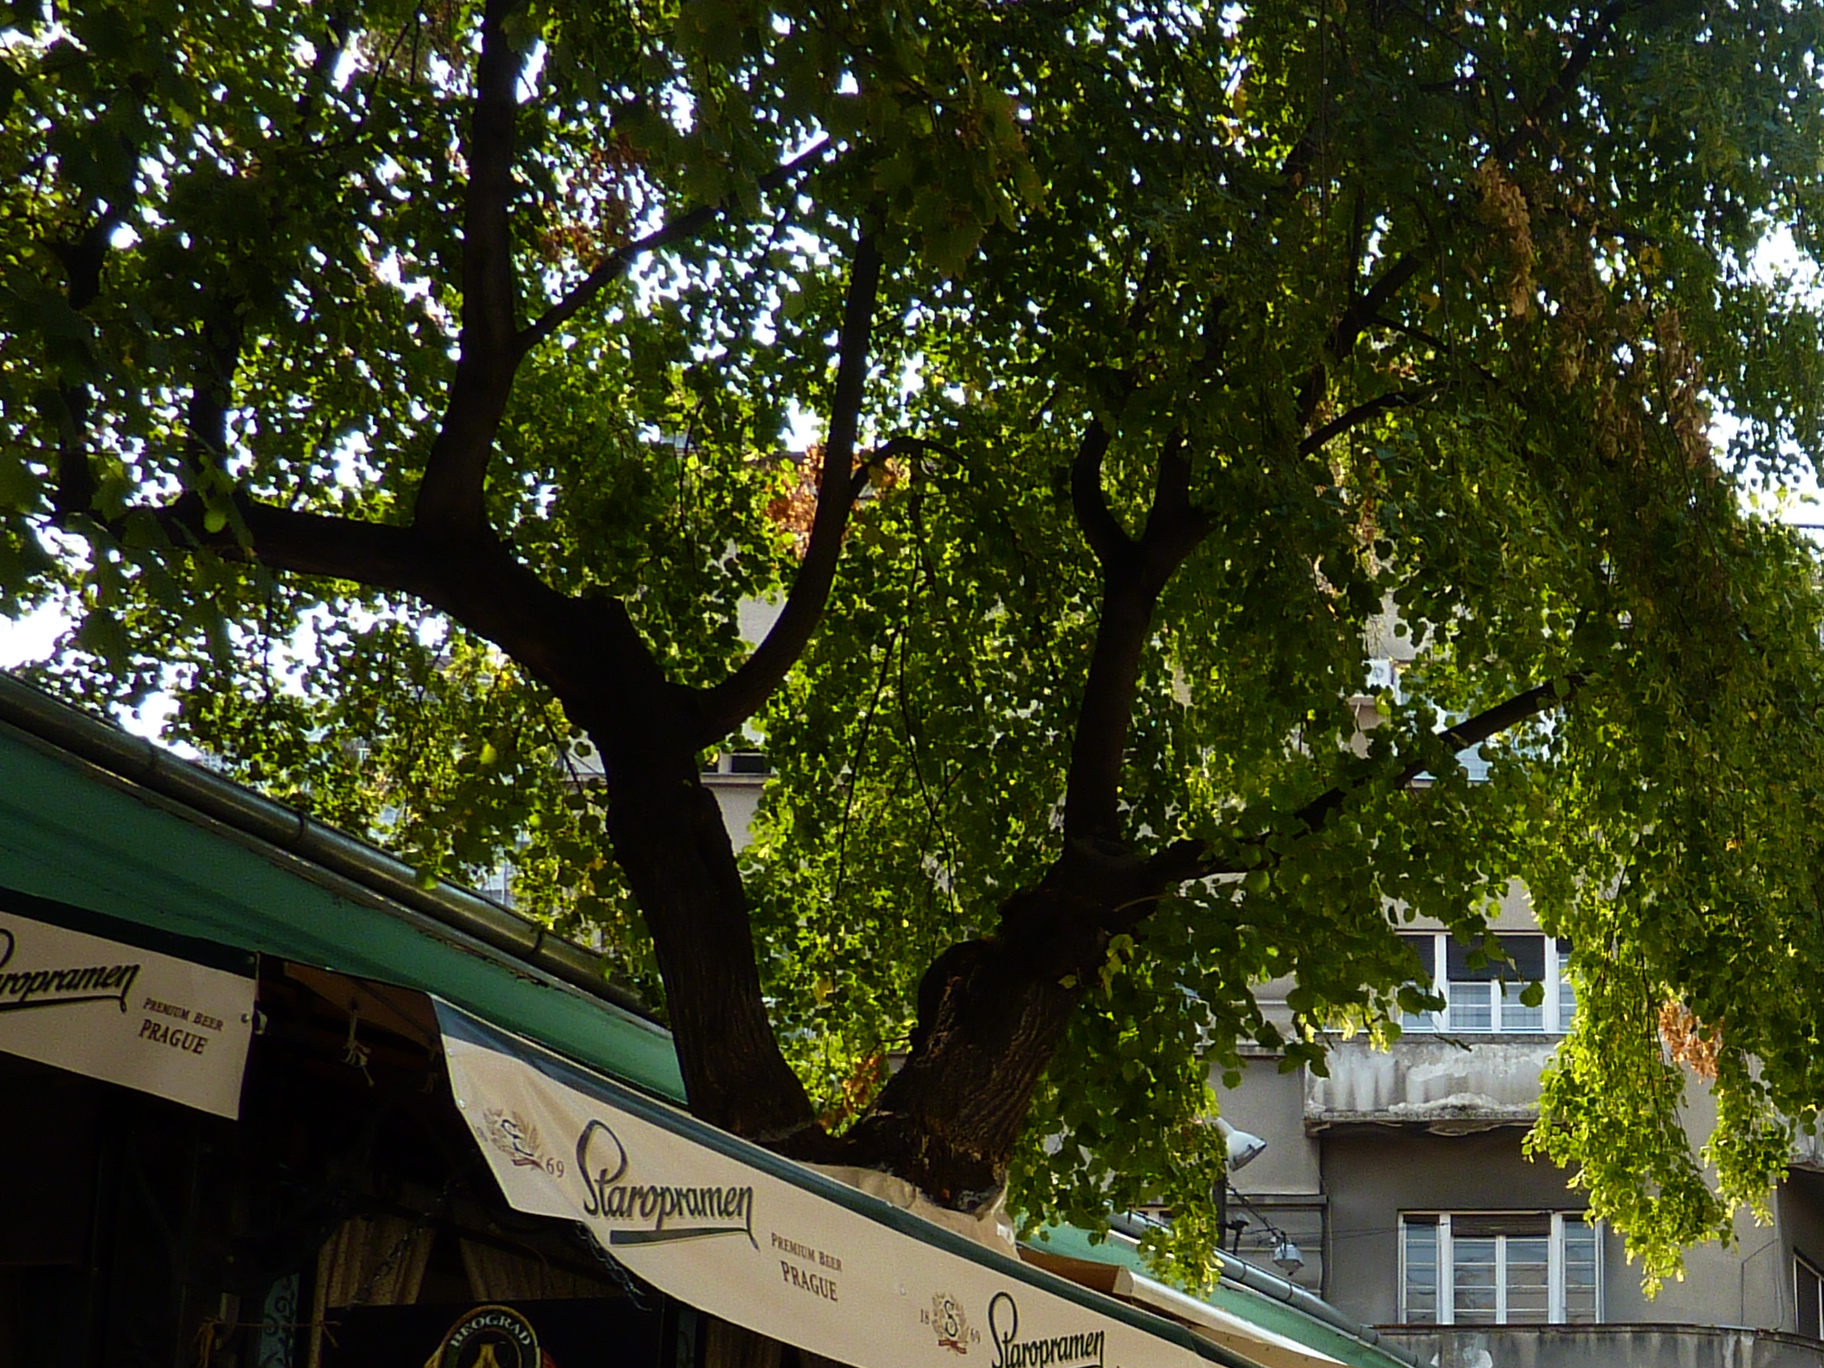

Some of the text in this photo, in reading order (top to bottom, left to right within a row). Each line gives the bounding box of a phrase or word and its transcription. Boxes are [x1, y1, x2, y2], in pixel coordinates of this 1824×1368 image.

[0, 929, 140, 1012] ropramen
[142, 997, 224, 1032] PREMIUM BEER
[138, 1018, 209, 1055] PRAGUE
[576, 1119, 760, 1248] Staropramen
[771, 1232, 842, 1272] PREMIUM BEER
[780, 1260, 838, 1302] PRAGUE
[449, 1313, 532, 1348] BEOGRAD
